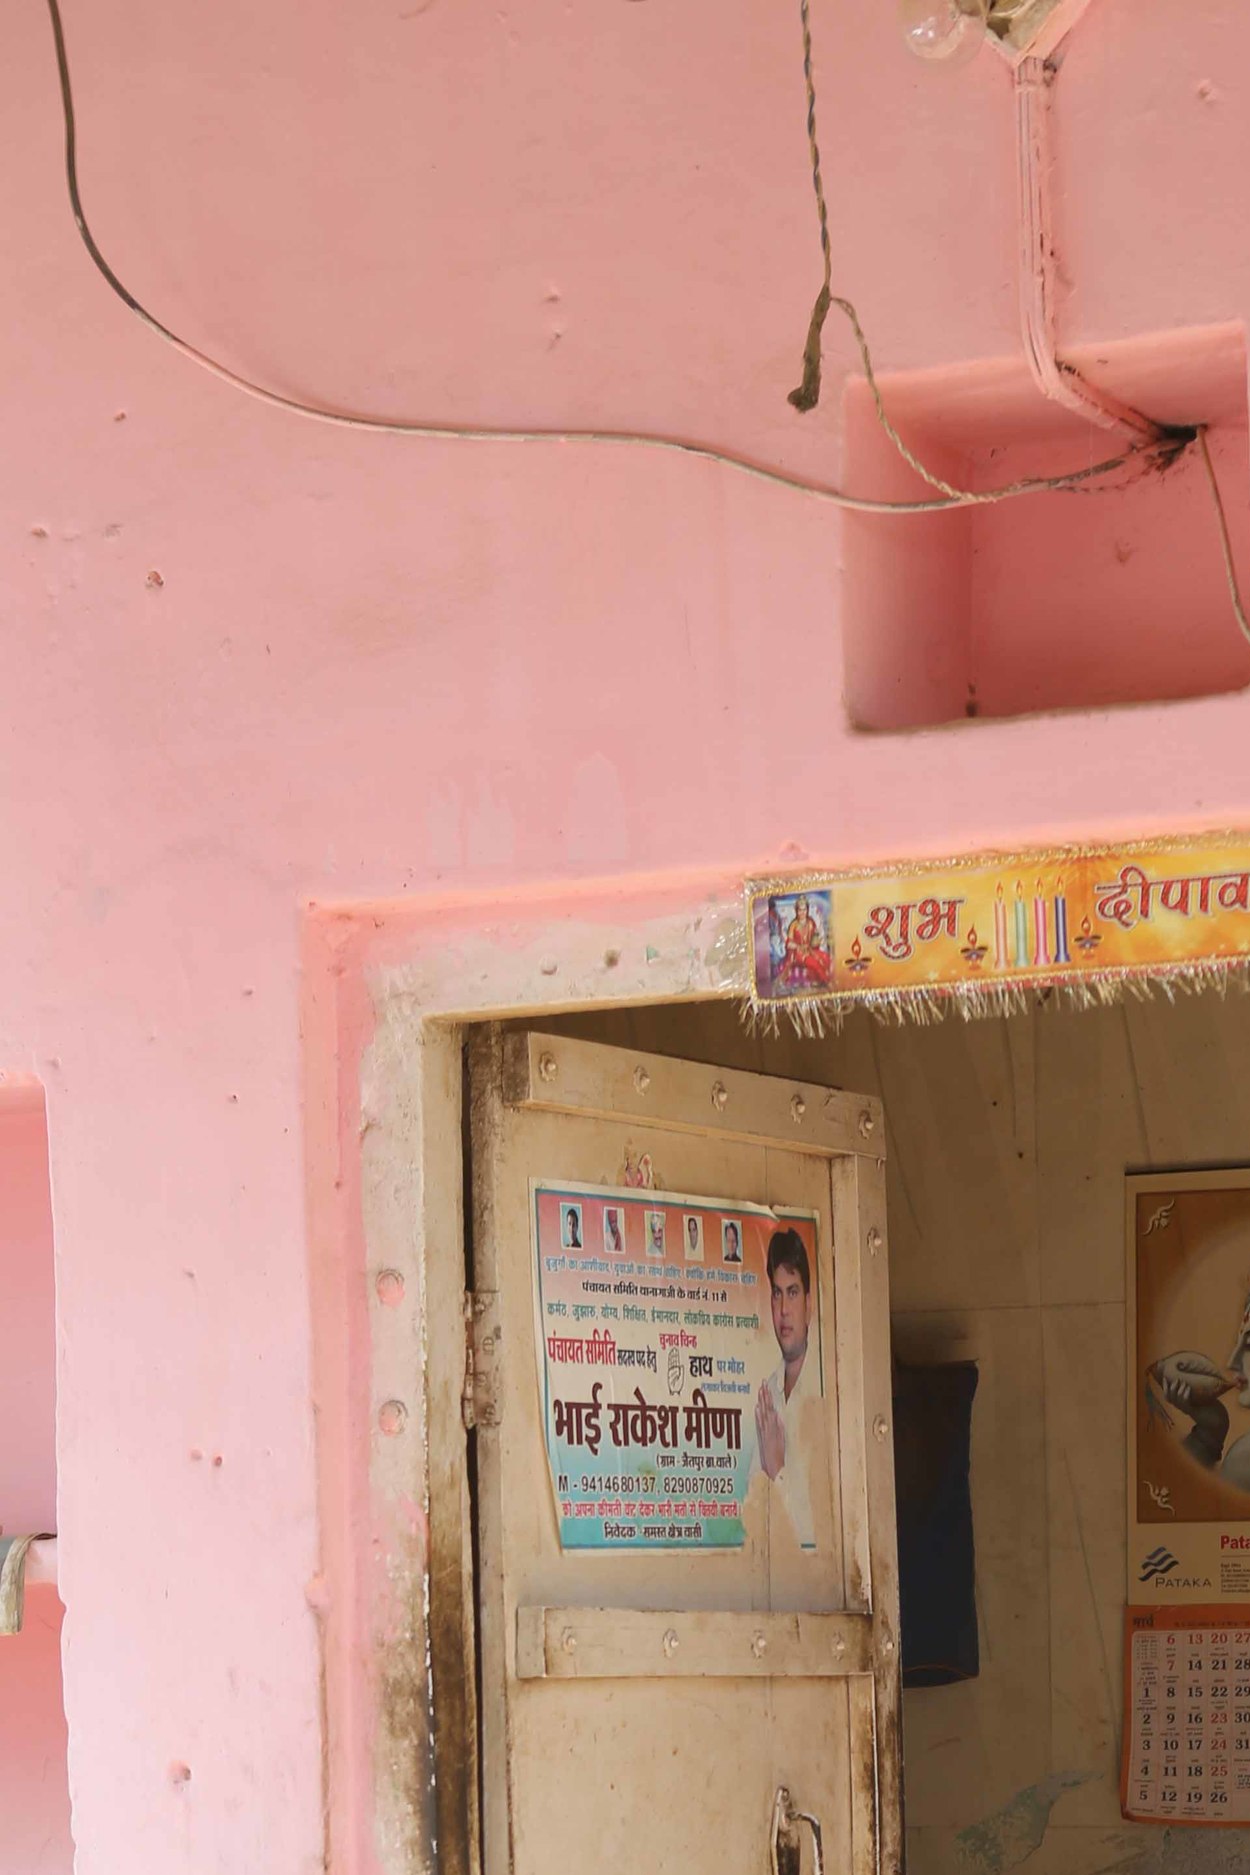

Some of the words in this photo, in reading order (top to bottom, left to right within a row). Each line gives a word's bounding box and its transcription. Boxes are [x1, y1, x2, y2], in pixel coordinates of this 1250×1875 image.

[863, 898, 966, 960] शुभ
[582, 1282, 611, 1293] पंचायत
[613, 1282, 638, 1295] समिति
[677, 1287, 686, 1299] के
[720, 1291, 727, 1302] से
[659, 1333, 679, 1350] चुनाव
[681, 1329, 697, 1349] चिन्ह
[547, 1331, 583, 1364] पंचायत
[586, 1328, 616, 1365] समिति
[636, 1350, 646, 1369] पद
[646, 1346, 658, 1373] हेतु
[689, 1355, 713, 1377] हाथ
[717, 1360, 727, 1375] पर
[728, 1357, 745, 1375] मोहर
[553, 1382, 603, 1455] भाई
[608, 1386, 679, 1450] राकेश
[684, 1387, 742, 1450] मीणा
[681, 1452, 704, 1472] जैतपुर
[558, 1475, 568, 1492] M
[664, 1478, 734, 1493] 8290870925
[574, 1501, 595, 1517] अपना
[597, 1498, 622, 1517] कीमती
[689, 1500, 696, 1517] से
[604, 1521, 636, 1539] निवेदक
[643, 1524, 667, 1538] समस्त
[667, 1523, 683, 1539] क्षेत्र
[684, 1521, 702, 1538] वासी
[1155, 1576, 1212, 1588] PATAKA
[1188, 1659, 1203, 1671] 14
[1211, 1659, 1227, 1671] 21
[1143, 1687, 1150, 1698] 1
[1166, 1686, 1176, 1698] 8
[1188, 1686, 1203, 1698] 15
[1210, 1685, 1229, 1698] 22
[1142, 1713, 1151, 1725] 2
[1166, 1712, 1176, 1725] 9
[1188, 1712, 1203, 1724] 16
[1142, 1739, 1151, 1751] 3
[1163, 1739, 1179, 1751] 10
[1188, 1739, 1203, 1751] 17
[1235, 1738, 1250, 1750] 31
[1140, 1764, 1149, 1776] 4
[1163, 1766, 1177, 1777] 11
[1187, 1765, 1203, 1777] 18
[1139, 1789, 1148, 1801] 5
[1161, 1790, 1178, 1802] 12
[1186, 1791, 1203, 1804] 19
[1210, 1791, 1226, 1804] 26
